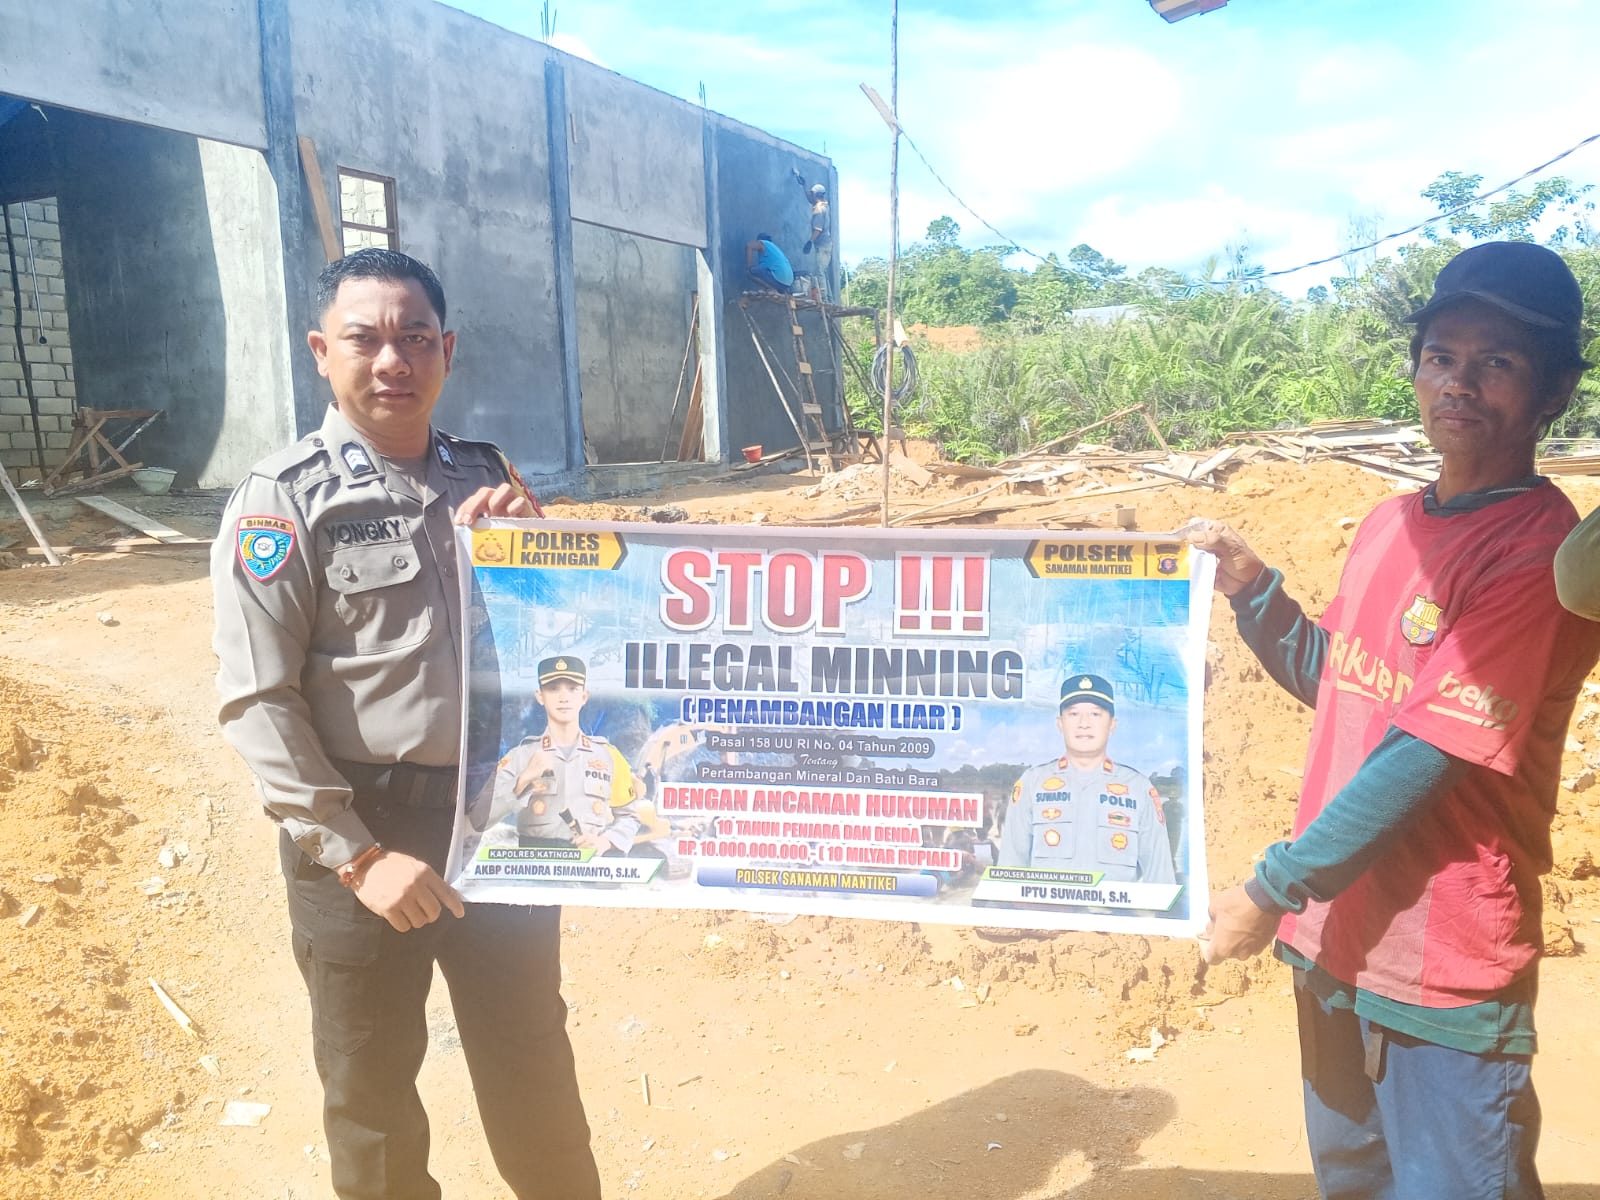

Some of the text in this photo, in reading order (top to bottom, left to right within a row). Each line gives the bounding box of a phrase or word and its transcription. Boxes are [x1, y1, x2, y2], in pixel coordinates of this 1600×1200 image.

[324, 519, 401, 545] YONGKY
[521, 531, 600, 551] POLRES
[520, 551, 600, 567] KATINGAN
[1043, 543, 1134, 562] POLSEK
[1045, 563, 1132, 575] SANAMAN MANTIKEI
[662, 548, 870, 630] STOP
[625, 642, 1024, 699] ILLEGAL MINNING
[1437, 670, 1519, 723] beko
[711, 736, 930, 754] Pasal 158 UU RI No. 04 Tahun 2009
[800, 754, 838, 769] Tentang
[702, 768, 938, 787] Pertambangan Mineral Dan Batu Bara
[663, 787, 748, 812] DENGAN
[753, 790, 860, 816] ANCAMAN
[866, 794, 978, 822] HUKUMAN
[1099, 793, 1137, 810] POLRI
[717, 819, 920, 843] 10 TAHUN PENJARA DAN DENDA
[489, 850, 581, 859] KAPOLRES KATINGAN
[678, 840, 697, 856] RP.
[846, 847, 895, 864] MILYAR
[474, 864, 641, 880] AKBP CHANDRA ISMAWANTO, S.I.K.
[736, 868, 897, 891] POLSEK SANAMAN MANTIKEI
[990, 869, 1025, 879] KAPOLSEK
[1021, 885, 1132, 905] IPTU SUWARDI, S.H.
